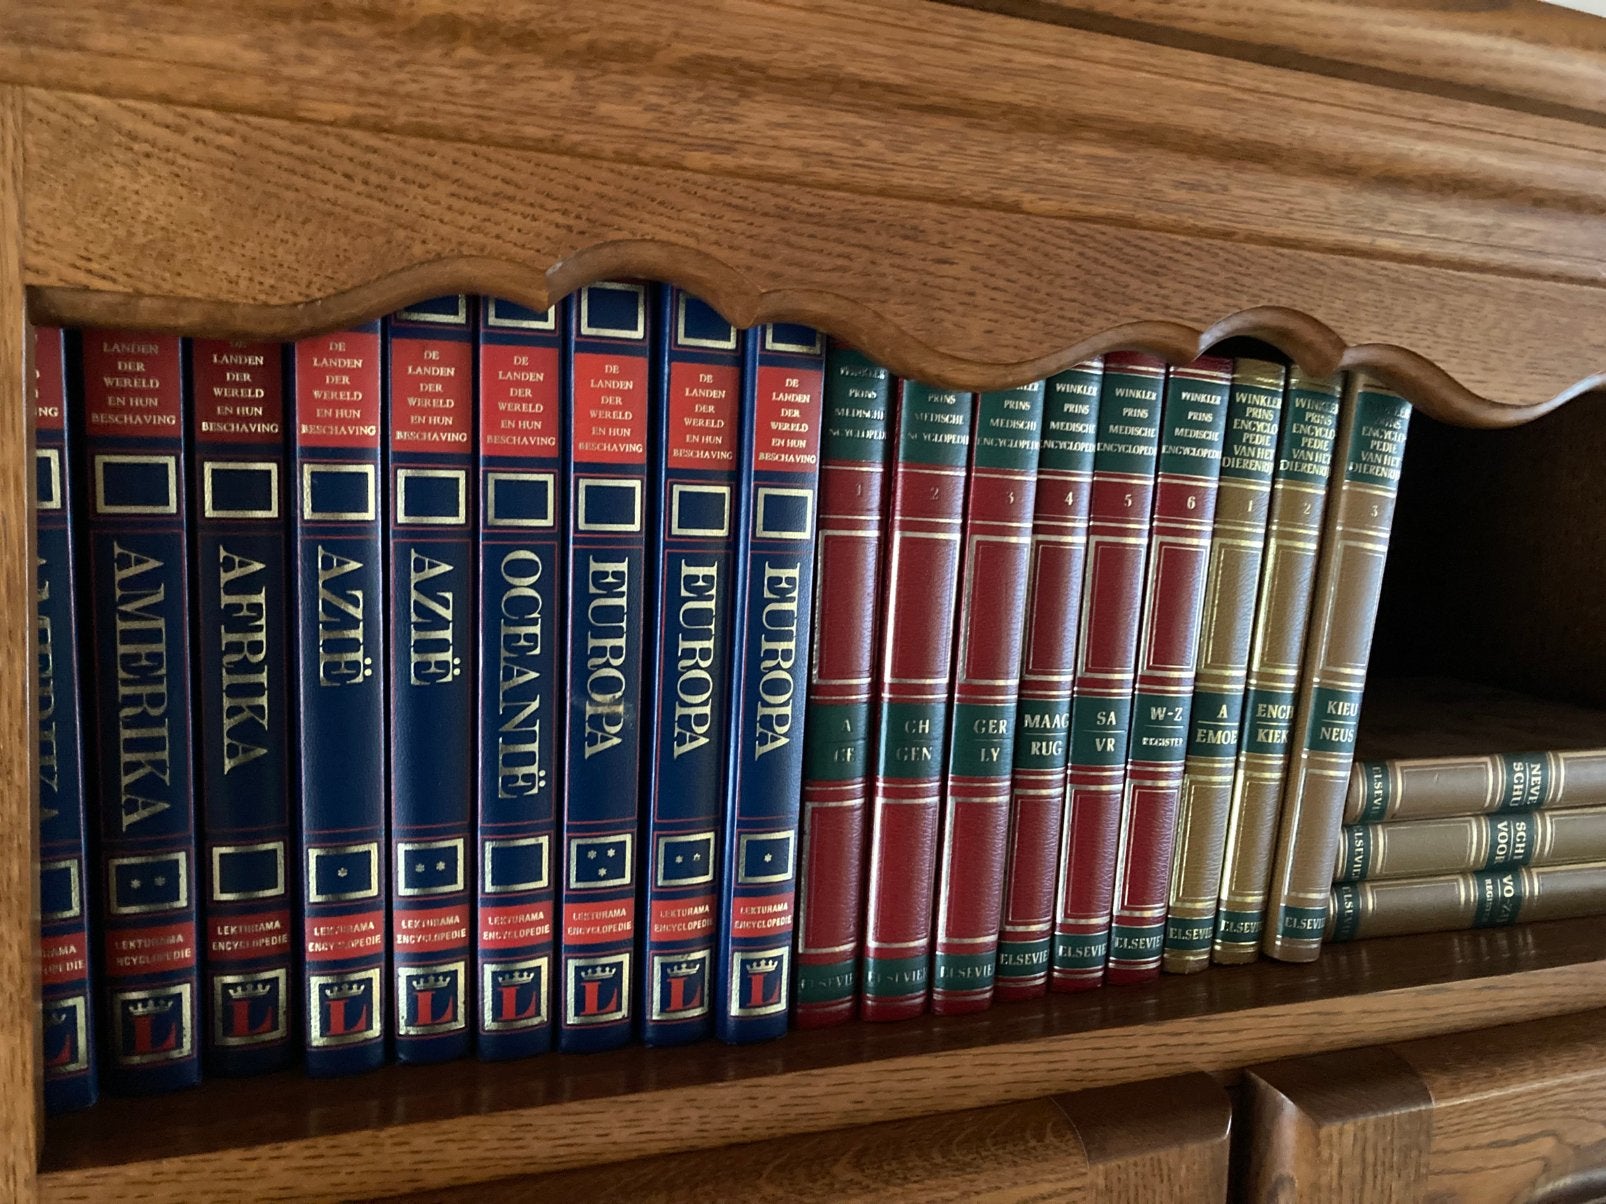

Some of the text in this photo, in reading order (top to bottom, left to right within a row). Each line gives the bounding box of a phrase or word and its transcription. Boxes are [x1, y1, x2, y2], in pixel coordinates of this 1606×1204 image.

[103, 342, 159, 354] LANDEN
[329, 341, 346, 351] DE
[213, 354, 264, 365] LANDEN
[424, 351, 440, 360] DE
[513, 356, 529, 366] DE
[117, 361, 146, 371] DER
[313, 357, 363, 368] LANDEN
[408, 365, 455, 377] LANDEN
[605, 364, 620, 374] DE
[226, 372, 251, 382] DER
[325, 375, 351, 385] DER
[498, 370, 544, 382] LANDEN
[699, 373, 713, 383] DE
[103, 377, 160, 389] WERELD
[420, 383, 444, 393] DER
[590, 379, 633, 390] LANDEN
[785, 378, 799, 388] DE
[213, 387, 265, 399] WERELD
[313, 389, 363, 401] WERELD
[509, 388, 533, 397] DER
[684, 387, 726, 399] LANDEN
[1055, 383, 1098, 397] WINKLER
[1115, 387, 1157, 401] WINKLER
[107, 396, 159, 407] EN HUN
[407, 397, 455, 408] WERELD
[601, 396, 622, 405] DER
[771, 392, 811, 403] LANDEN
[1181, 392, 1222, 405] WINKLER
[217, 405, 263, 416] EN HUN
[498, 401, 543, 413] WERELD
[694, 404, 716, 414] DER
[1004, 400, 1031, 411] PRINS
[1063, 403, 1090, 415] PRINS
[316, 408, 361, 419] EN HUN
[589, 409, 633, 420] WERELD
[780, 408, 800, 418] DER
[1122, 407, 1149, 419] PRINS
[1187, 411, 1213, 422] PRINS
[1245, 406, 1274, 419] PRINS
[1305, 411, 1332, 425] PRINS
[91, 413, 176, 425] BESCHAVING
[410, 415, 453, 426] EN HUN
[501, 419, 542, 430] EN HUN
[683, 417, 725, 428] WERELD
[202, 420, 279, 433] BESCHAVING
[301, 424, 376, 436] BESCHAVING
[592, 427, 631, 437] EN HUN
[770, 421, 809, 433] WERELD
[395, 431, 467, 442] BESCHAVING
[486, 435, 556, 446] BESCHAVING
[685, 434, 723, 445] EN HUN
[1242, 432, 1271, 447] PEDIE
[578, 441, 642, 453] BESCHAVING
[771, 438, 807, 448] EN HUN
[1301, 437, 1329, 452] PEDIE
[1370, 440, 1397, 453] PEDIE
[672, 448, 733, 460] BESCHAVING
[758, 452, 816, 464] BESCHAVING
[1233, 444, 1275, 460] VAN HET
[1292, 448, 1332, 464] VAN HET
[1360, 450, 1402, 468] VAN HET
[930, 486, 939, 500] 2
[1064, 491, 1074, 506] 4
[1124, 494, 1133, 507] 5
[1187, 496, 1196, 509] 6
[1247, 500, 1253, 512] 1
[1303, 503, 1311, 514] 2
[1371, 504, 1378, 517] 3
[317, 544, 372, 687] AZIË
[410, 548, 461, 686] AZIË
[219, 545, 268, 776] AFRIKA
[584, 554, 629, 760] EUROPA
[673, 558, 718, 760] EUROPA
[755, 560, 800, 762] EUROPA
[498, 549, 546, 798] OCEANIË
[114, 540, 171, 832] AMERIKA
[1150, 706, 1183, 722] W-Z
[1217, 704, 1228, 719] A
[1327, 700, 1359, 716] KIEU
[1096, 711, 1117, 726] SA
[973, 719, 1008, 734] GER
[1319, 727, 1354, 743] NEUS
[1030, 740, 1063, 756] RUG
[1095, 737, 1116, 752] VR
[1142, 737, 1184, 747] REGISTER
[980, 747, 1000, 762] LY
[573, 907, 626, 921] LEKTURAMA
[660, 904, 710, 918] LEKTURAMA
[739, 902, 788, 915] LEKTURAMA
[488, 911, 544, 926] LEKTURAMA
[667, 977, 701, 1011] L
[747, 972, 781, 1006] L
[497, 986, 537, 1020] L
[580, 981, 617, 1015] L
[413, 990, 453, 1025] L
[231, 999, 272, 1038] L
[327, 998, 367, 1035] L
[132, 1016, 176, 1057] L
